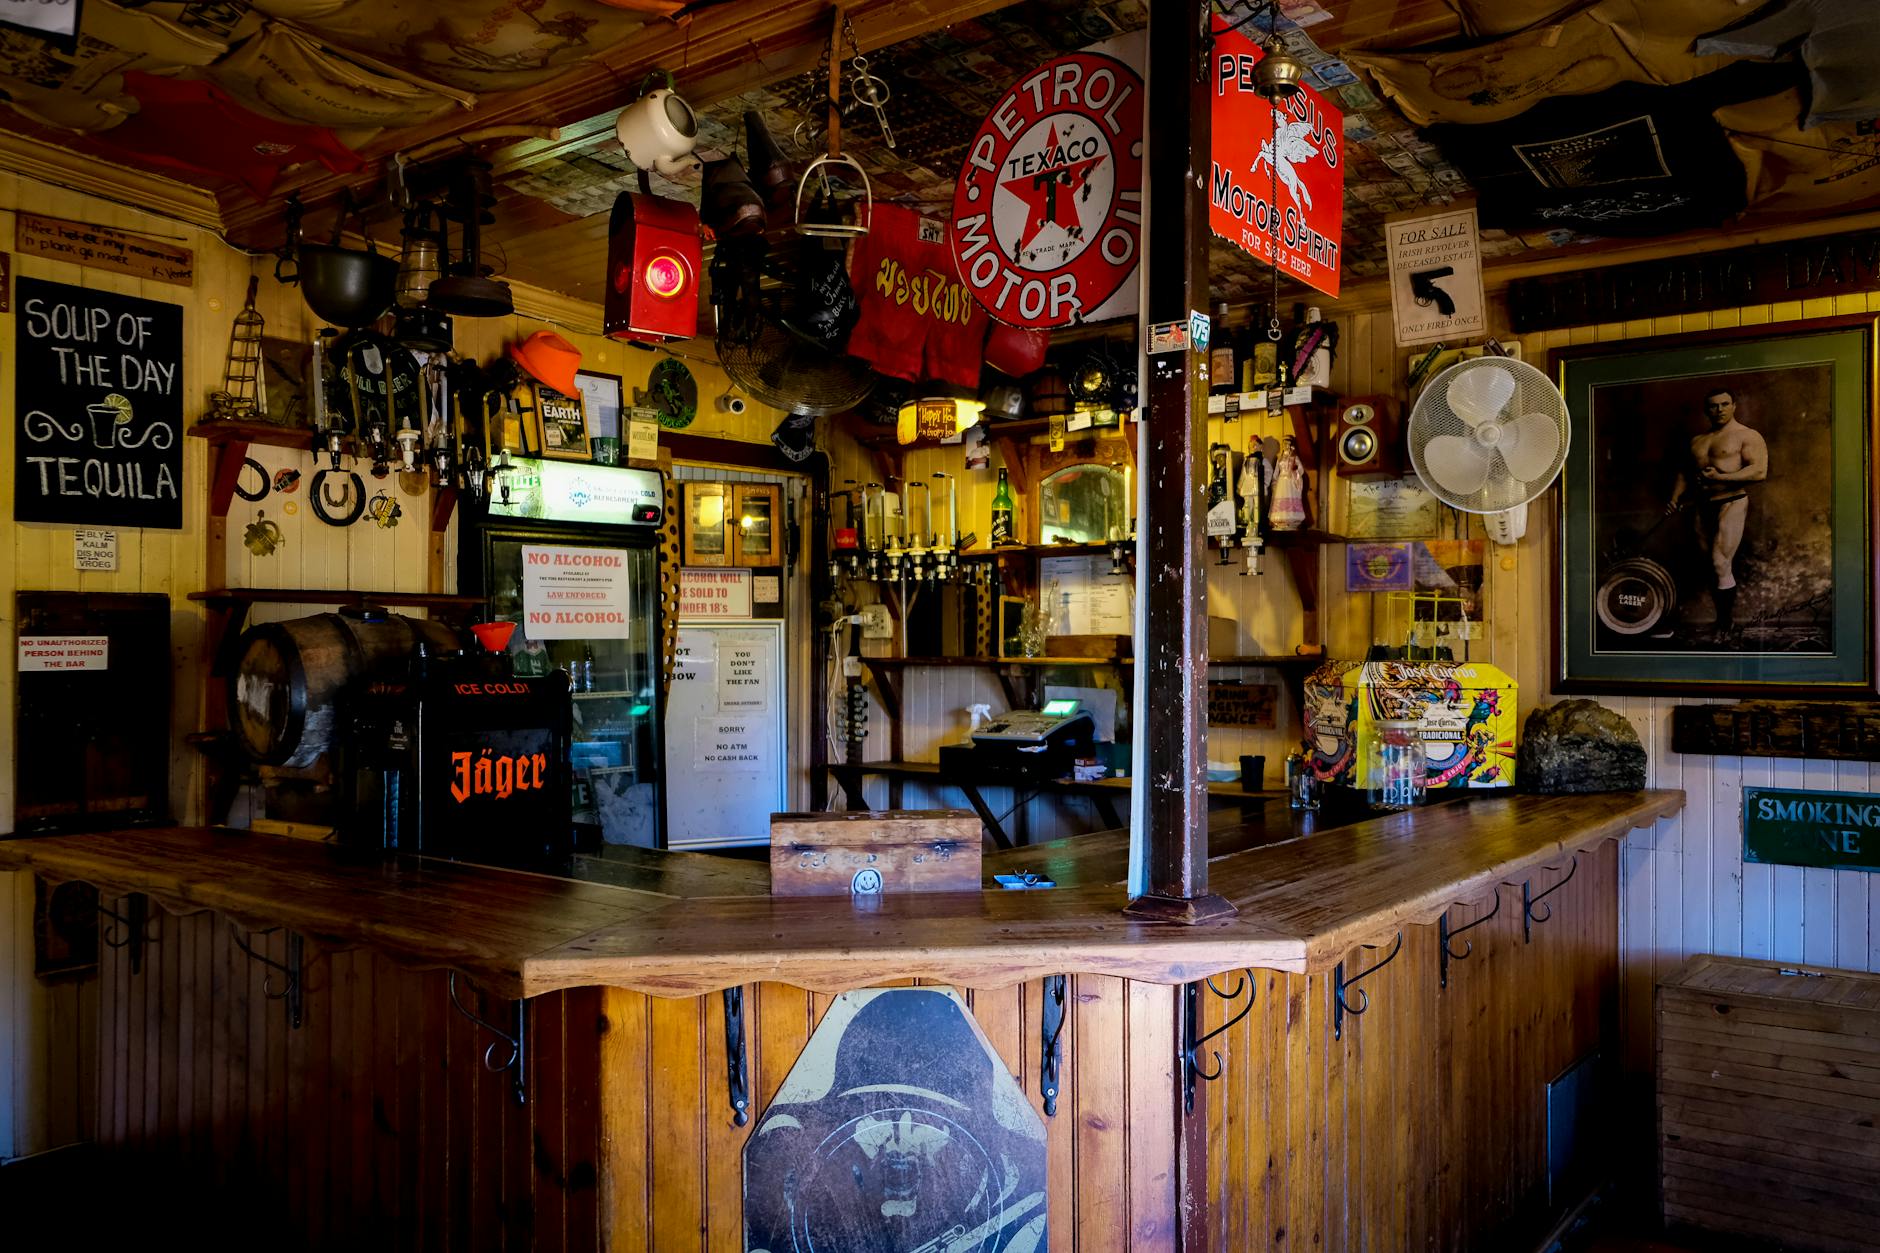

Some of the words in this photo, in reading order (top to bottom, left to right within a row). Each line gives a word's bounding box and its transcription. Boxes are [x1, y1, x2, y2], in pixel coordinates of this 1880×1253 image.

[969, 63, 1133, 173] PETROL
[1218, 54, 1337, 169] PESUS
[1008, 136, 1099, 179] TEXACO
[1398, 229, 1426, 245] FOR
[1431, 221, 1467, 240] SALE
[1242, 229, 1261, 251] FOR
[1290, 253, 1312, 278] HERE
[1398, 247, 1423, 259] IRISH
[1425, 240, 1469, 254] REVOLVER
[957, 214, 1083, 320] MOTOR
[1396, 256, 1440, 270] DECEASED
[1443, 250, 1474, 262] ESTATE
[25, 299, 111, 343] SOUP
[116, 313, 153, 351] OF
[1193, 320, 1209, 342] 175
[1401, 324, 1425, 335] ONLY
[1426, 320, 1452, 331] FIRED
[51, 346, 113, 388] THE
[121, 354, 175, 395] DAY
[543, 405, 581, 421] EARTH
[26, 456, 177, 500] TEQUILA
[86, 531, 105, 539] BLY
[82, 541, 108, 549] KALM
[76, 550, 92, 558] DIS
[94, 550, 114, 558] NOG
[528, 553, 550, 565] NO
[554, 554, 622, 567] ALCOHOL
[79, 560, 111, 568] VROEG
[682, 573, 718, 583] LCOHOL
[720, 573, 742, 584] WILL
[565, 592, 607, 600] ENFORCED
[690, 588, 713, 598] SOLD
[716, 587, 728, 598] TO
[530, 612, 552, 624] NO
[556, 612, 625, 624] ALCOHOL
[675, 648, 691, 656] OT
[66, 660, 85, 668] BAR
[454, 684, 484, 695] ICE
[487, 683, 530, 695] COLD!
[1419, 731, 1461, 740] TRADICIONAL
[450, 748, 547, 804] Jäger
[1758, 799, 1880, 827] SMOKING
